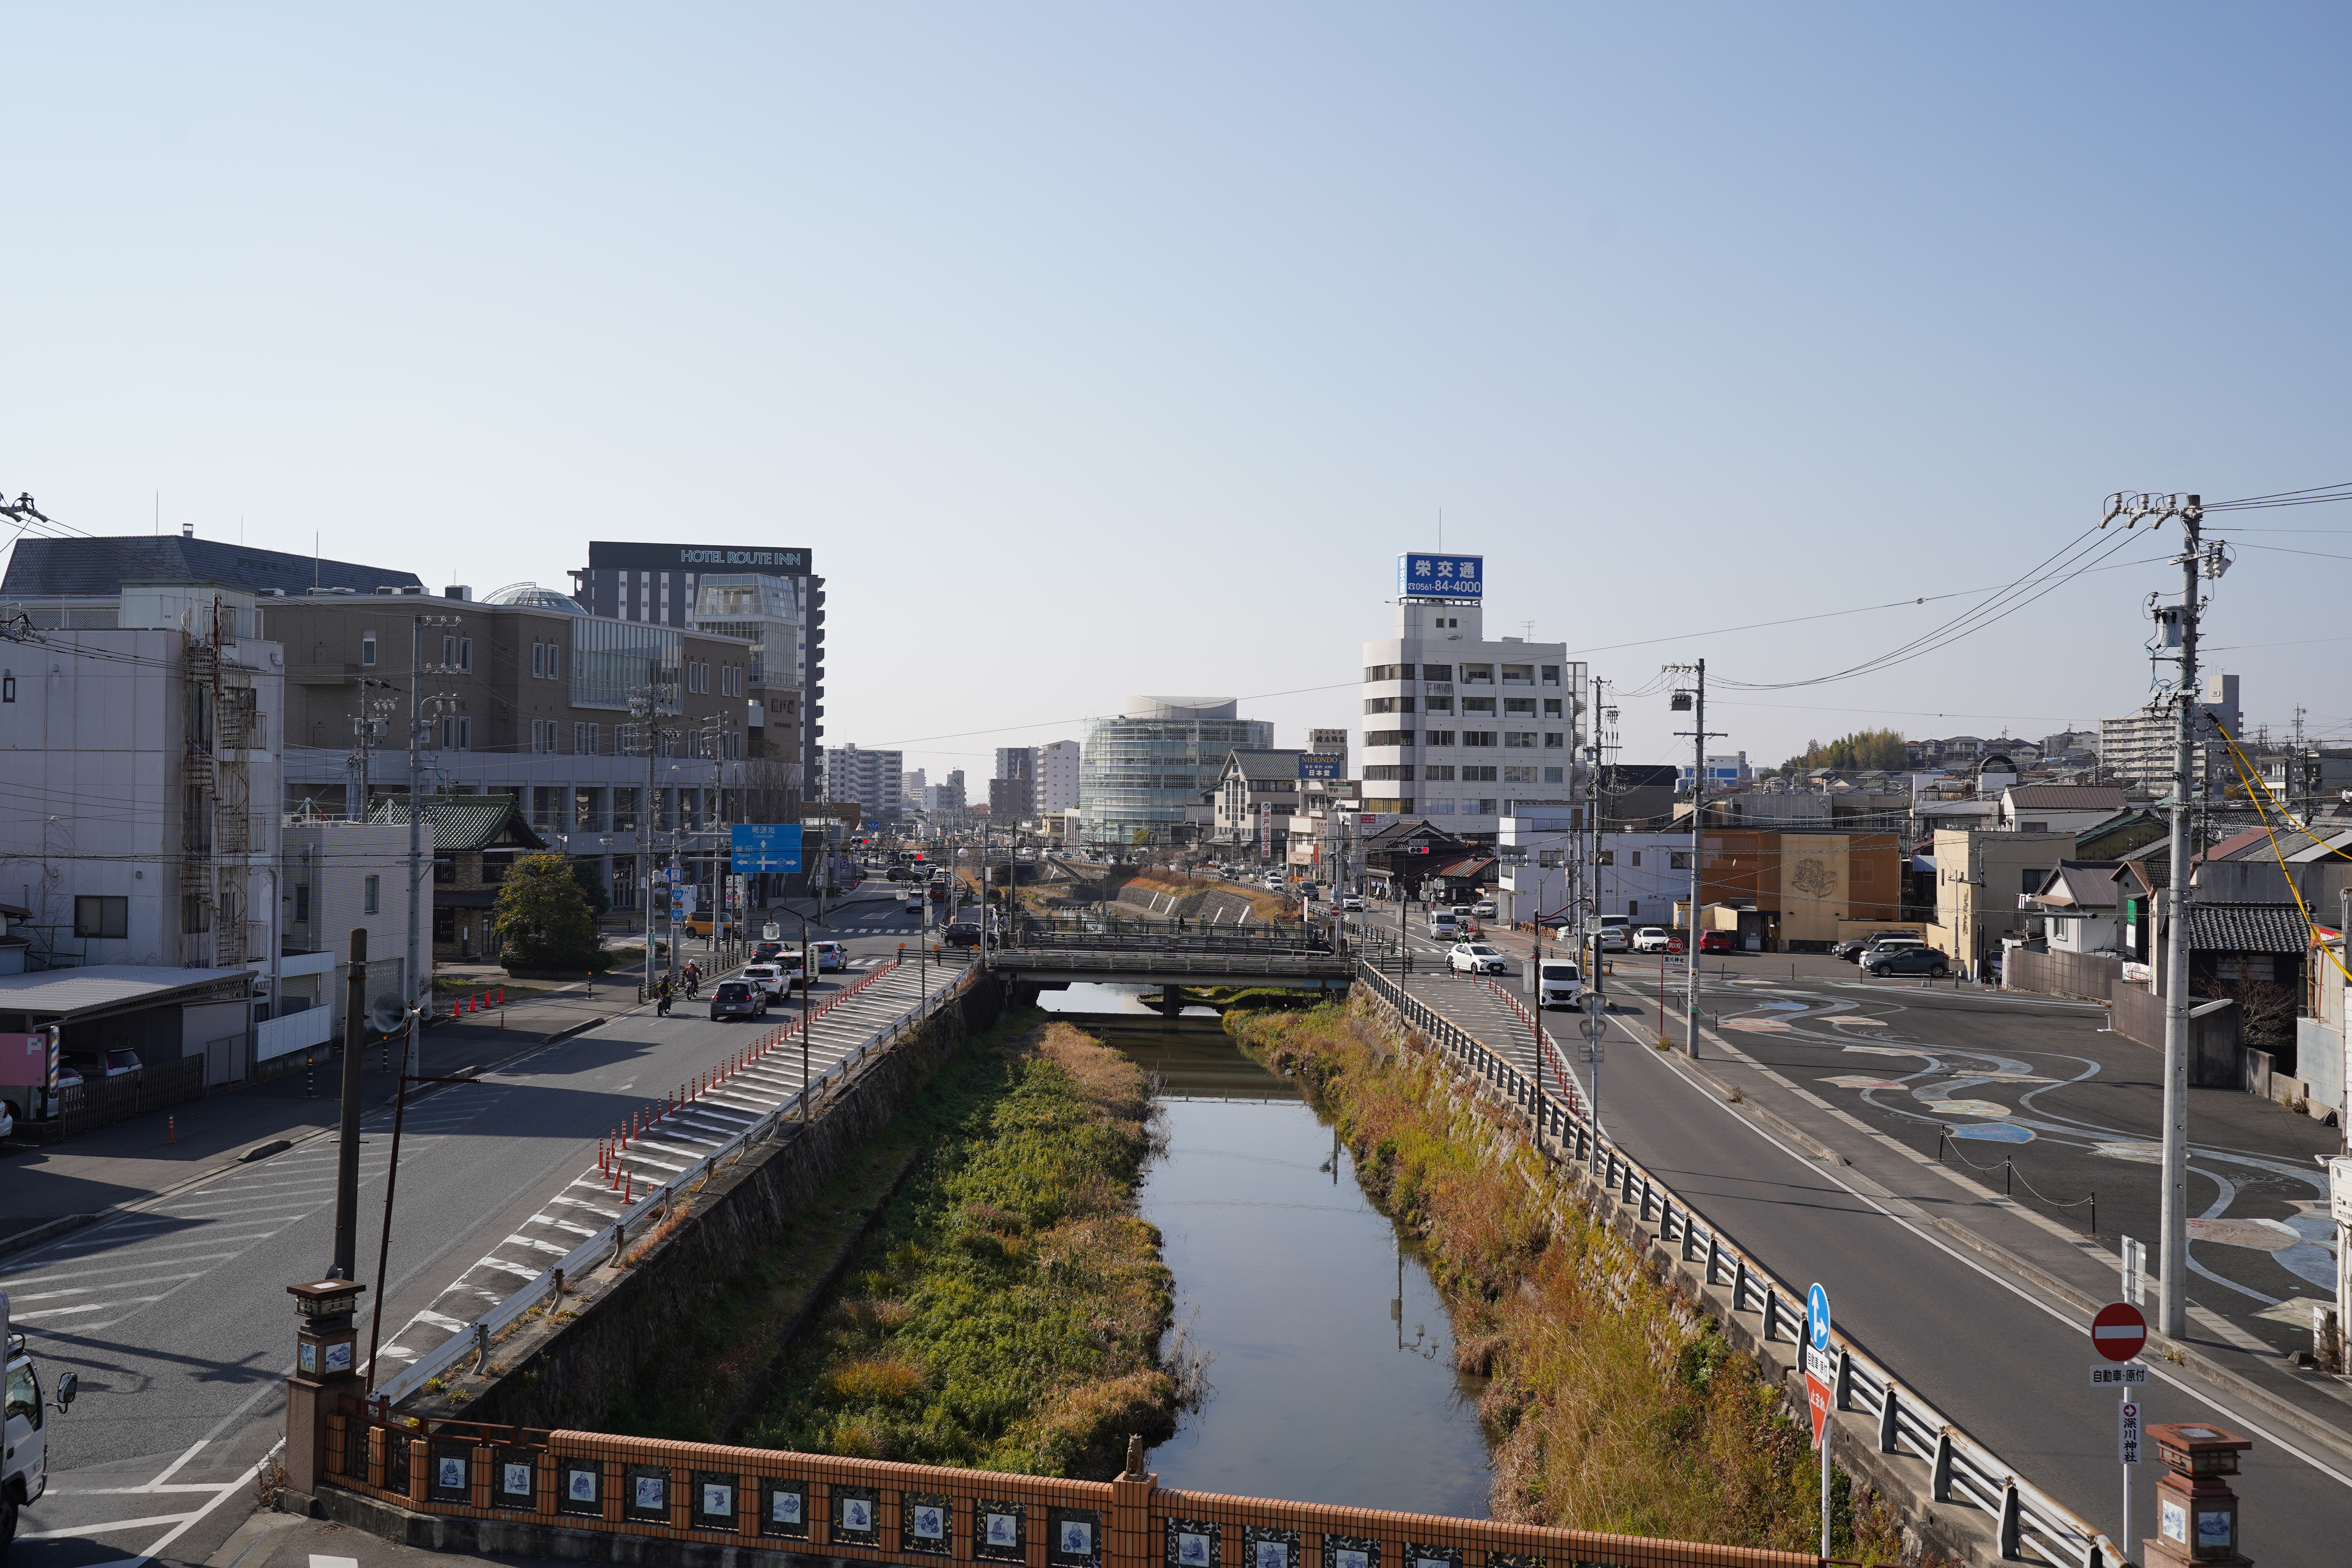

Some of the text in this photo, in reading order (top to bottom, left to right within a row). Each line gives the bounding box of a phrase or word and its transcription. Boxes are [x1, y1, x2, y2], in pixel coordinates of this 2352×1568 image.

[681, 550, 800, 565] HOTEL ROUTE INN
[1416, 560, 1475, 578] 栄交通
[1416, 580, 1481, 593] 0561-84-4000
[771, 698, 795, 714] 瀬戸蔵
[27, 1038, 42, 1054] P
[2094, 1369, 2145, 1382] 自動車・原付
[1810, 1389, 1825, 1412] 止まれ
[2123, 1417, 2137, 1462] 深川神社
